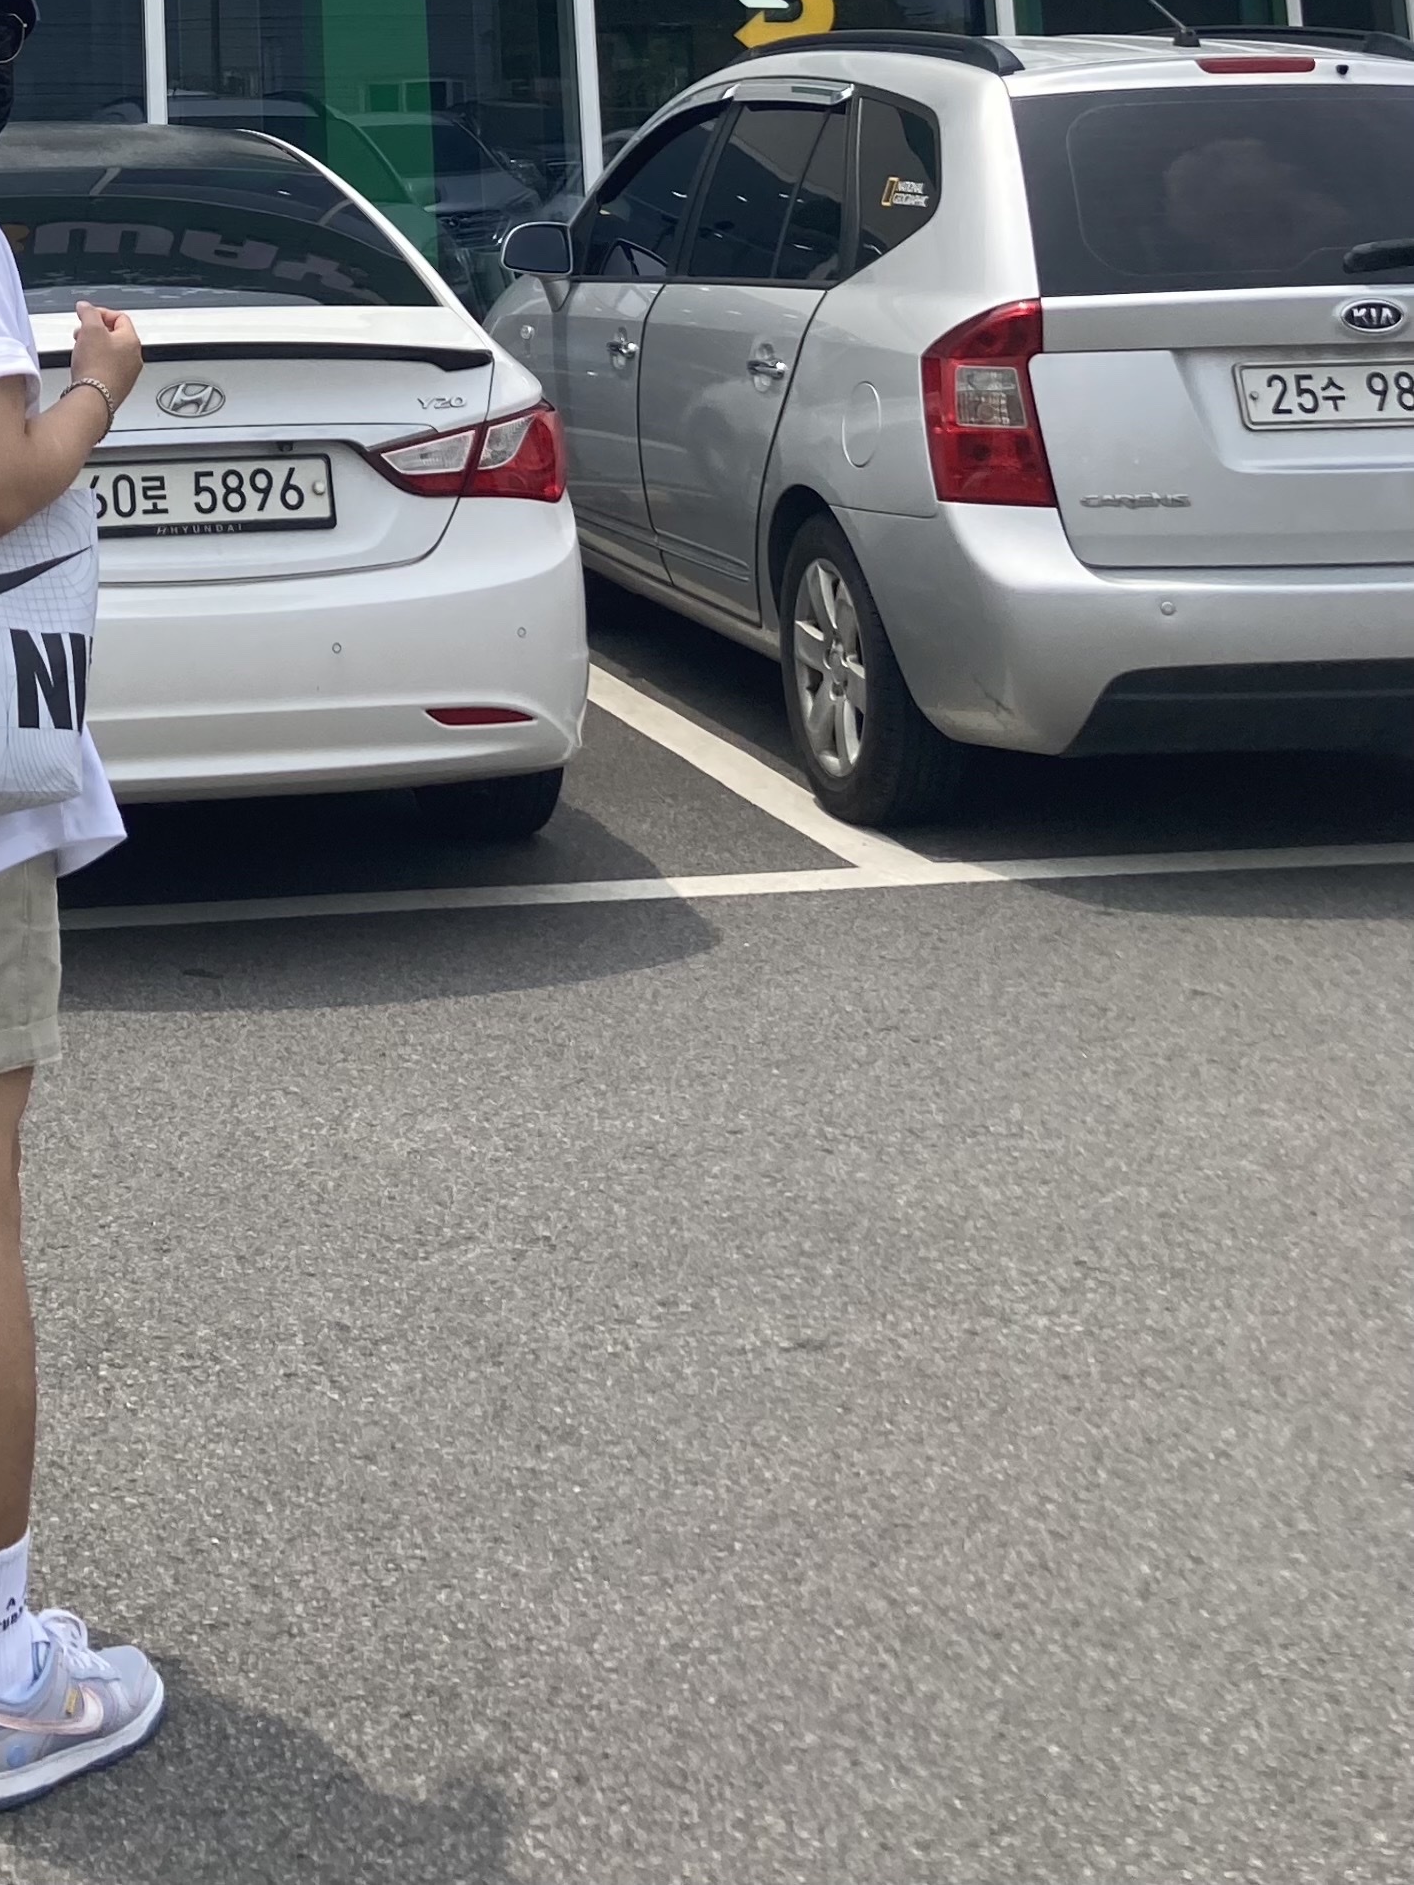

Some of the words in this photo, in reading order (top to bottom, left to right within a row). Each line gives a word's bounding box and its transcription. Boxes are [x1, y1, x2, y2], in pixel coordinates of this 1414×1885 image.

[1350, 307, 1396, 325] KIA
[416, 395, 468, 409] Y20
[1266, 373, 1346, 415] 25수
[89, 474, 169, 519] 60로
[193, 467, 305, 515] 5896
[1080, 491, 1192, 509] CARENS
[169, 524, 243, 535] HYUNDAI
[9, 627, 93, 736] NI
